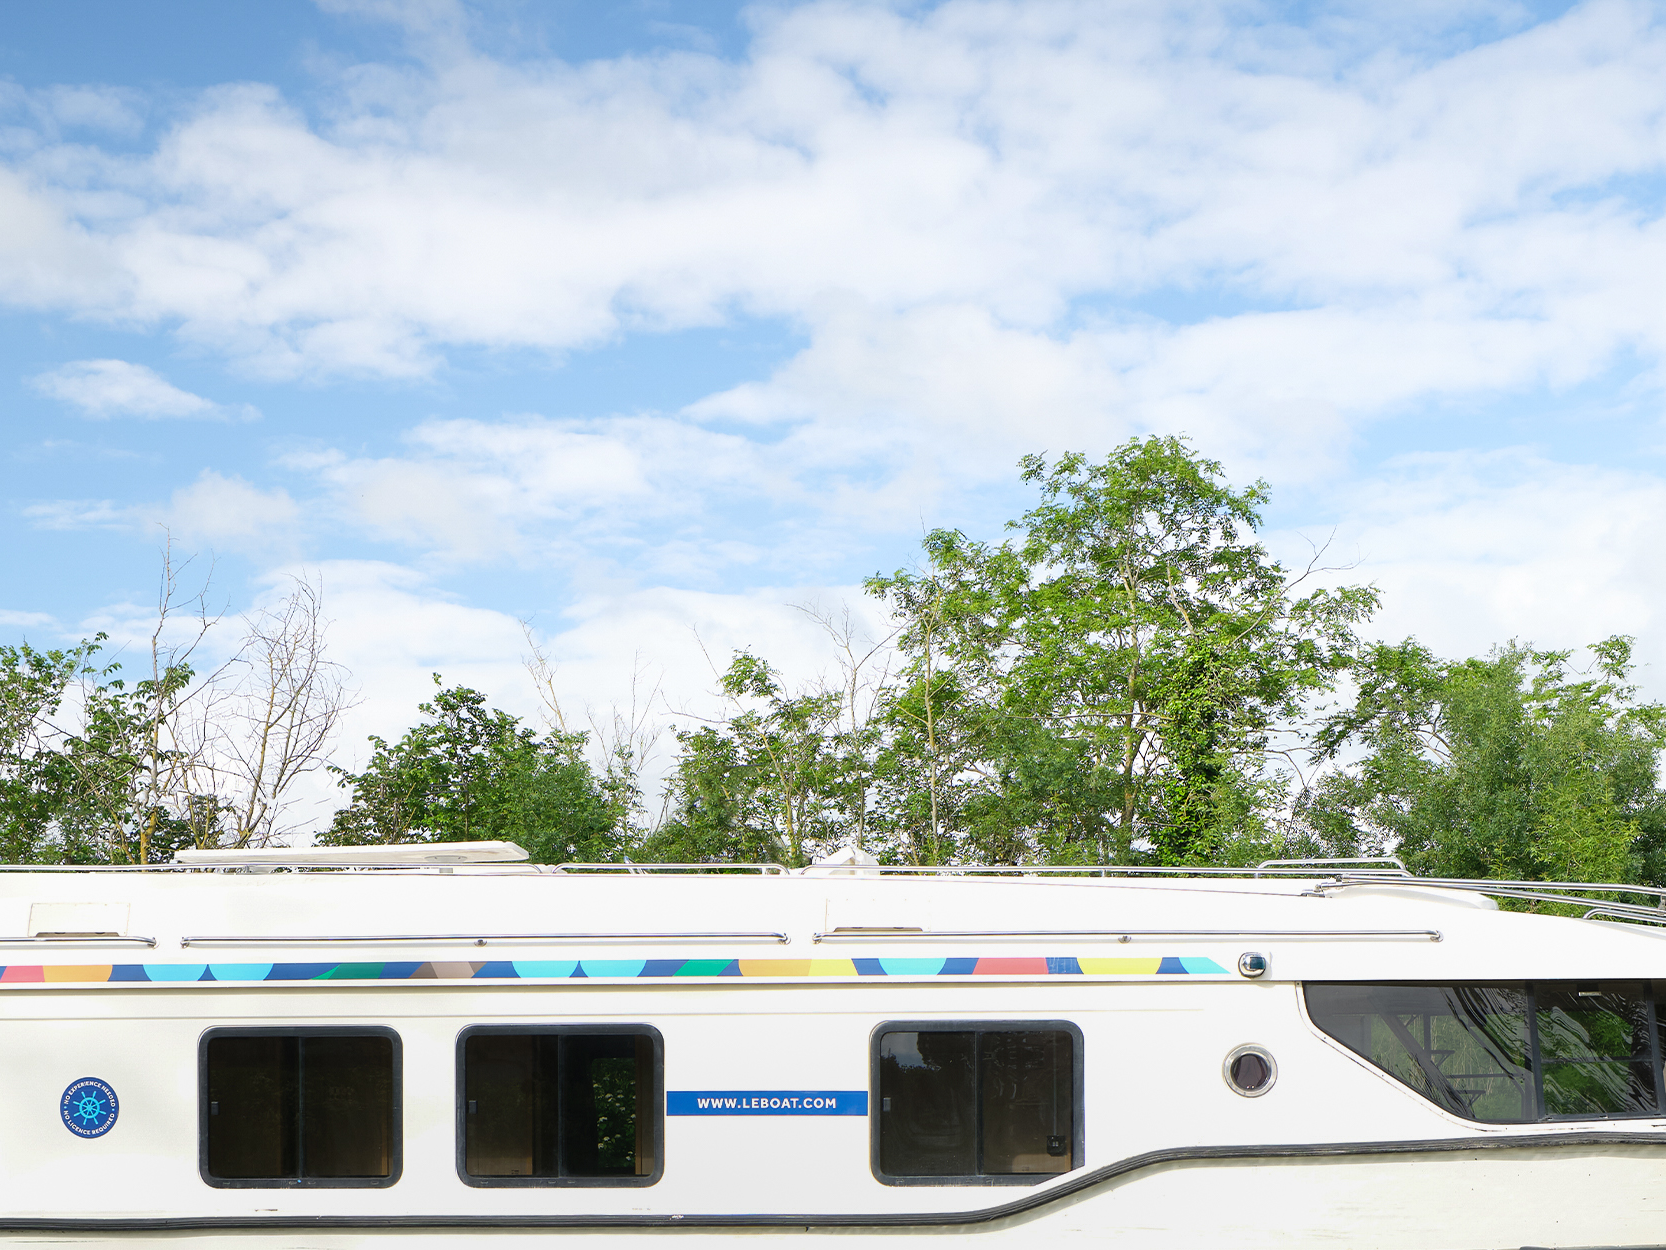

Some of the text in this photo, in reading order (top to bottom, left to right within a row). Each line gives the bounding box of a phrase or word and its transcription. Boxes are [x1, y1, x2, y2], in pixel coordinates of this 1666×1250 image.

[64, 1081, 115, 1107] NO EXPERIENCE NEEDED
[697, 1098, 836, 1109] WWW.LEBOAT.COM
[64, 1110, 115, 1135] NO LICENCE REQUIRED
